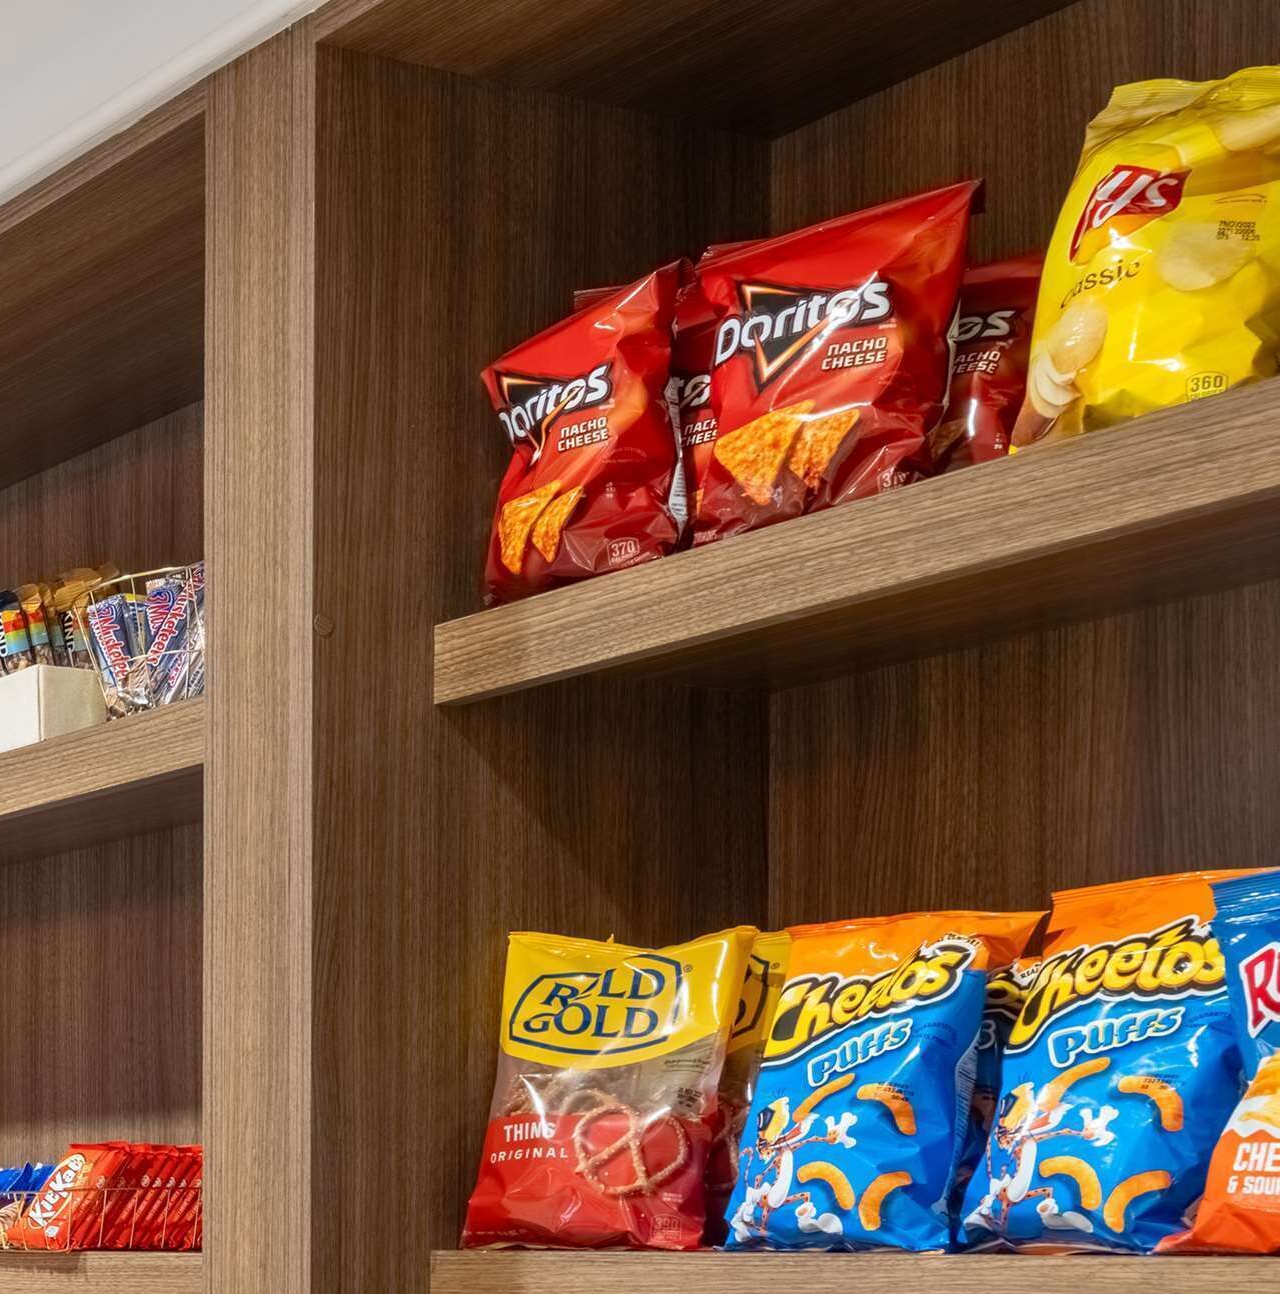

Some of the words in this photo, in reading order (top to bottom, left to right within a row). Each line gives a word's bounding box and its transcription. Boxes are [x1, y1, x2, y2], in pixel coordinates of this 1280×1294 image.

[715, 281, 891, 366] Doritos
[827, 336, 888, 357] NACHO
[955, 350, 1001, 363] ACHO
[820, 350, 887, 372] CHEESE
[1191, 374, 1224, 392] 360
[560, 416, 607, 438] NACHO
[557, 430, 609, 453] CHEESE
[679, 430, 718, 448] CHEES
[611, 540, 636, 558] 370
[540, 965, 665, 1008] RLD
[522, 1003, 660, 1039] GOLD
[490, 1147, 569, 1164] ORIGINAL
[1226, 1177, 1240, 1194] &
